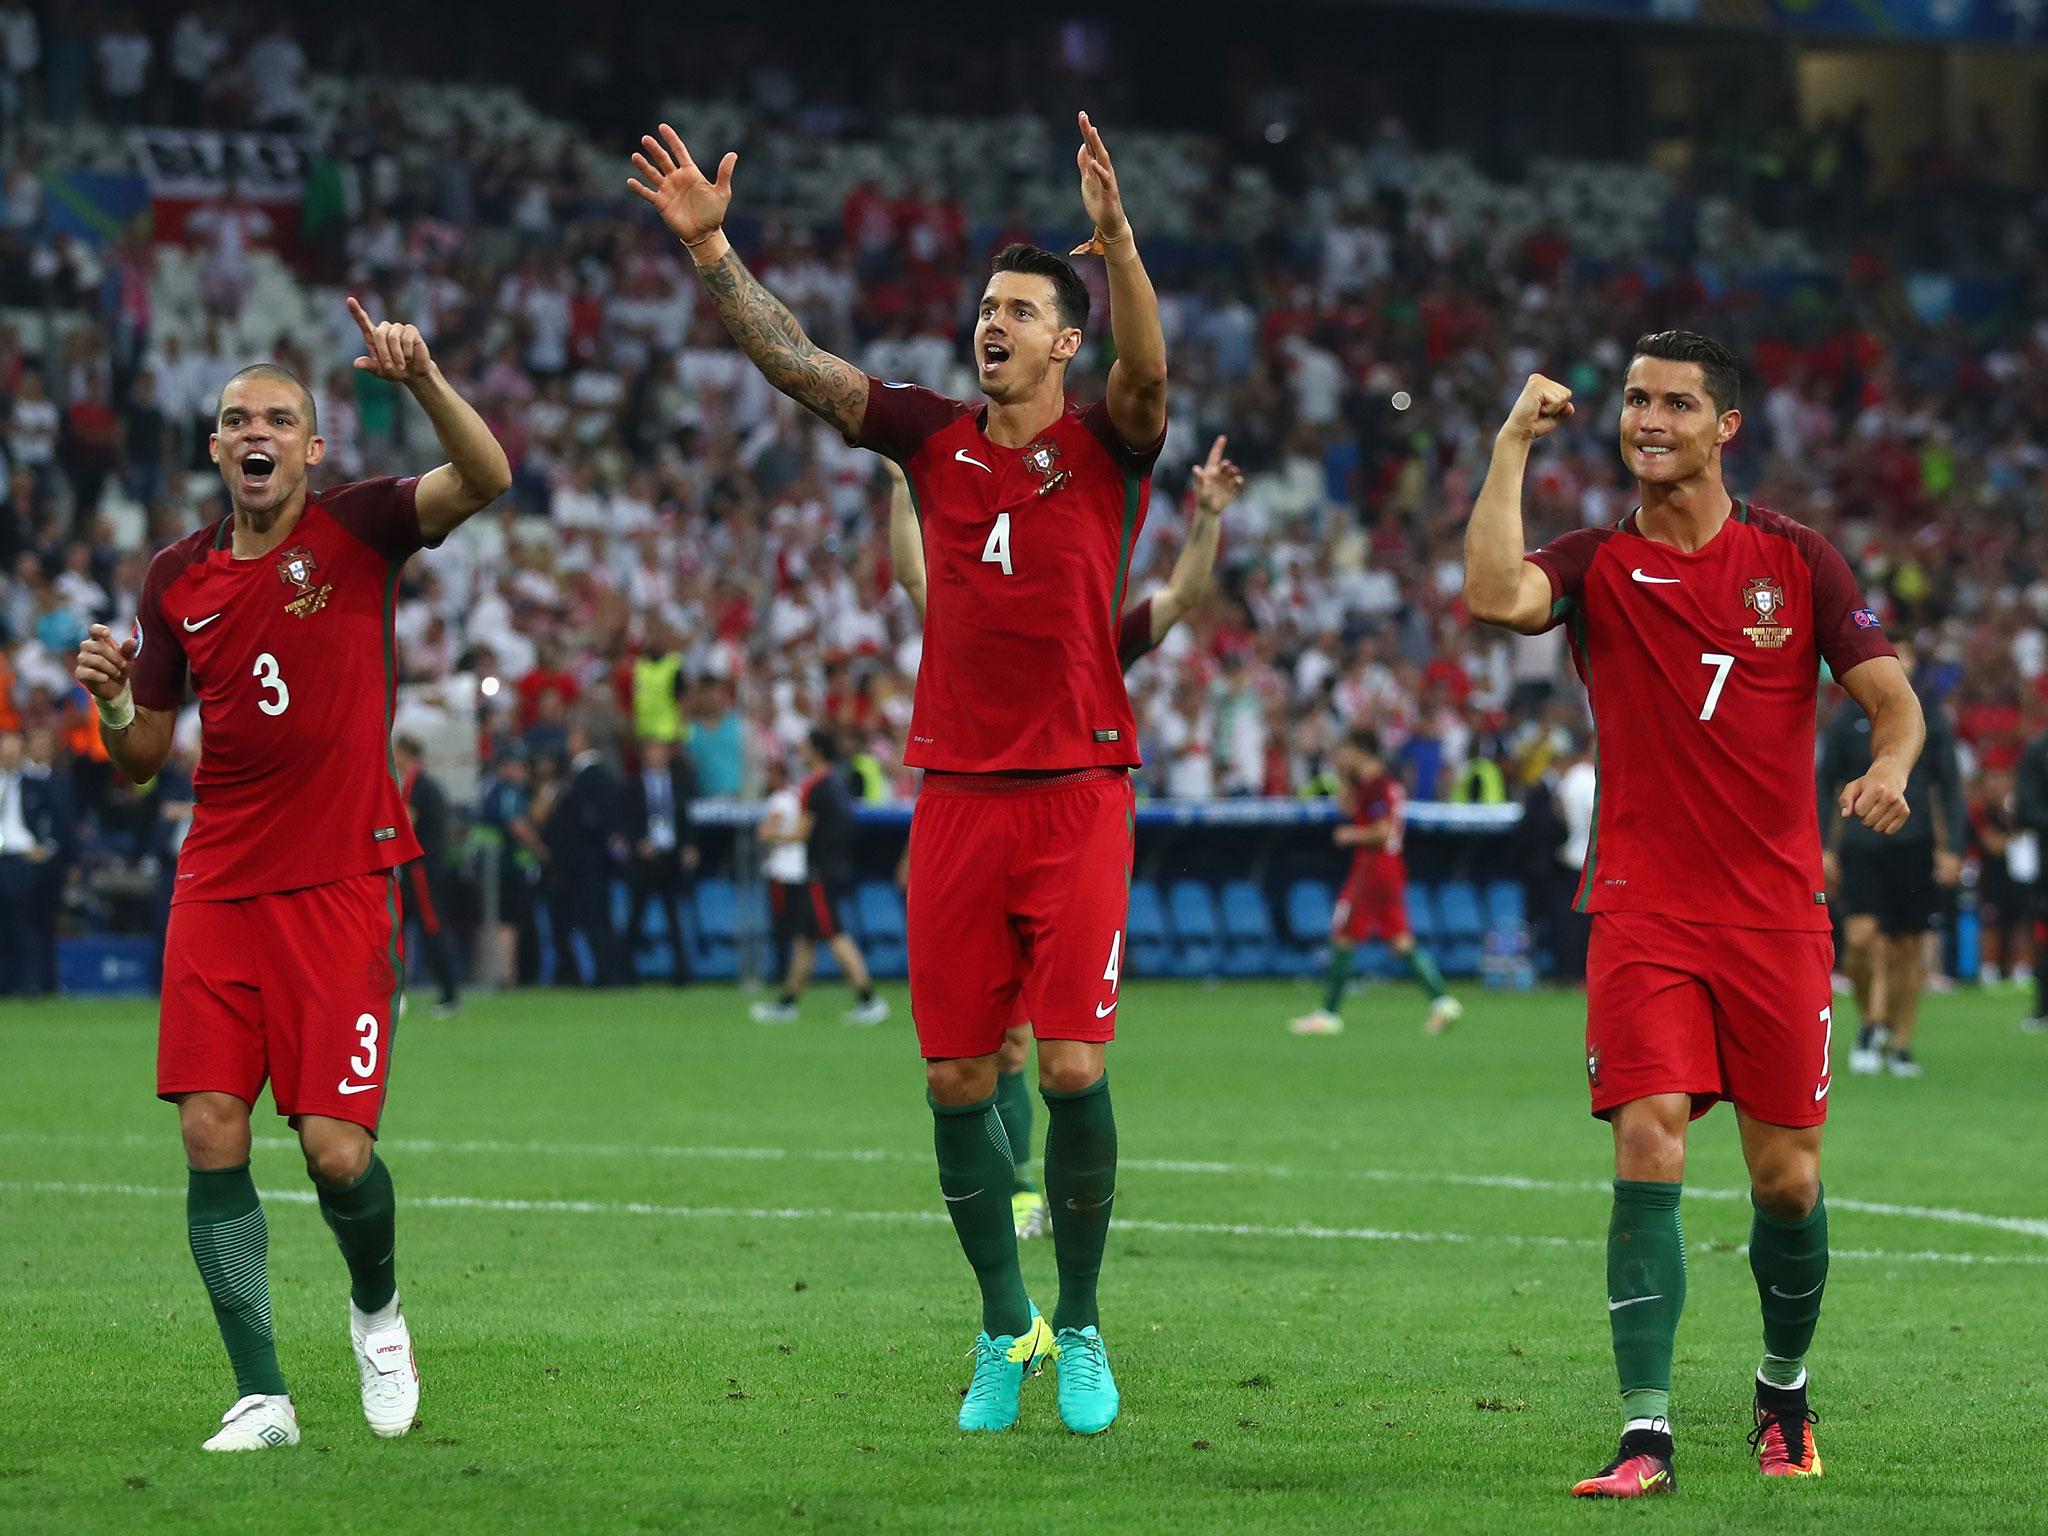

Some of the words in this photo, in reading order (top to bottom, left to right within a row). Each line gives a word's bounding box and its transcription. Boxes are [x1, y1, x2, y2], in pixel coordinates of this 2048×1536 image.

[982, 513, 1012, 575] 4
[253, 653, 289, 716] 3
[1699, 653, 1735, 721] 7
[1103, 930, 1120, 994] 4
[351, 1013, 378, 1078] 3
[1819, 1006, 1832, 1077] 7
[376, 1344, 403, 1354] umbro
